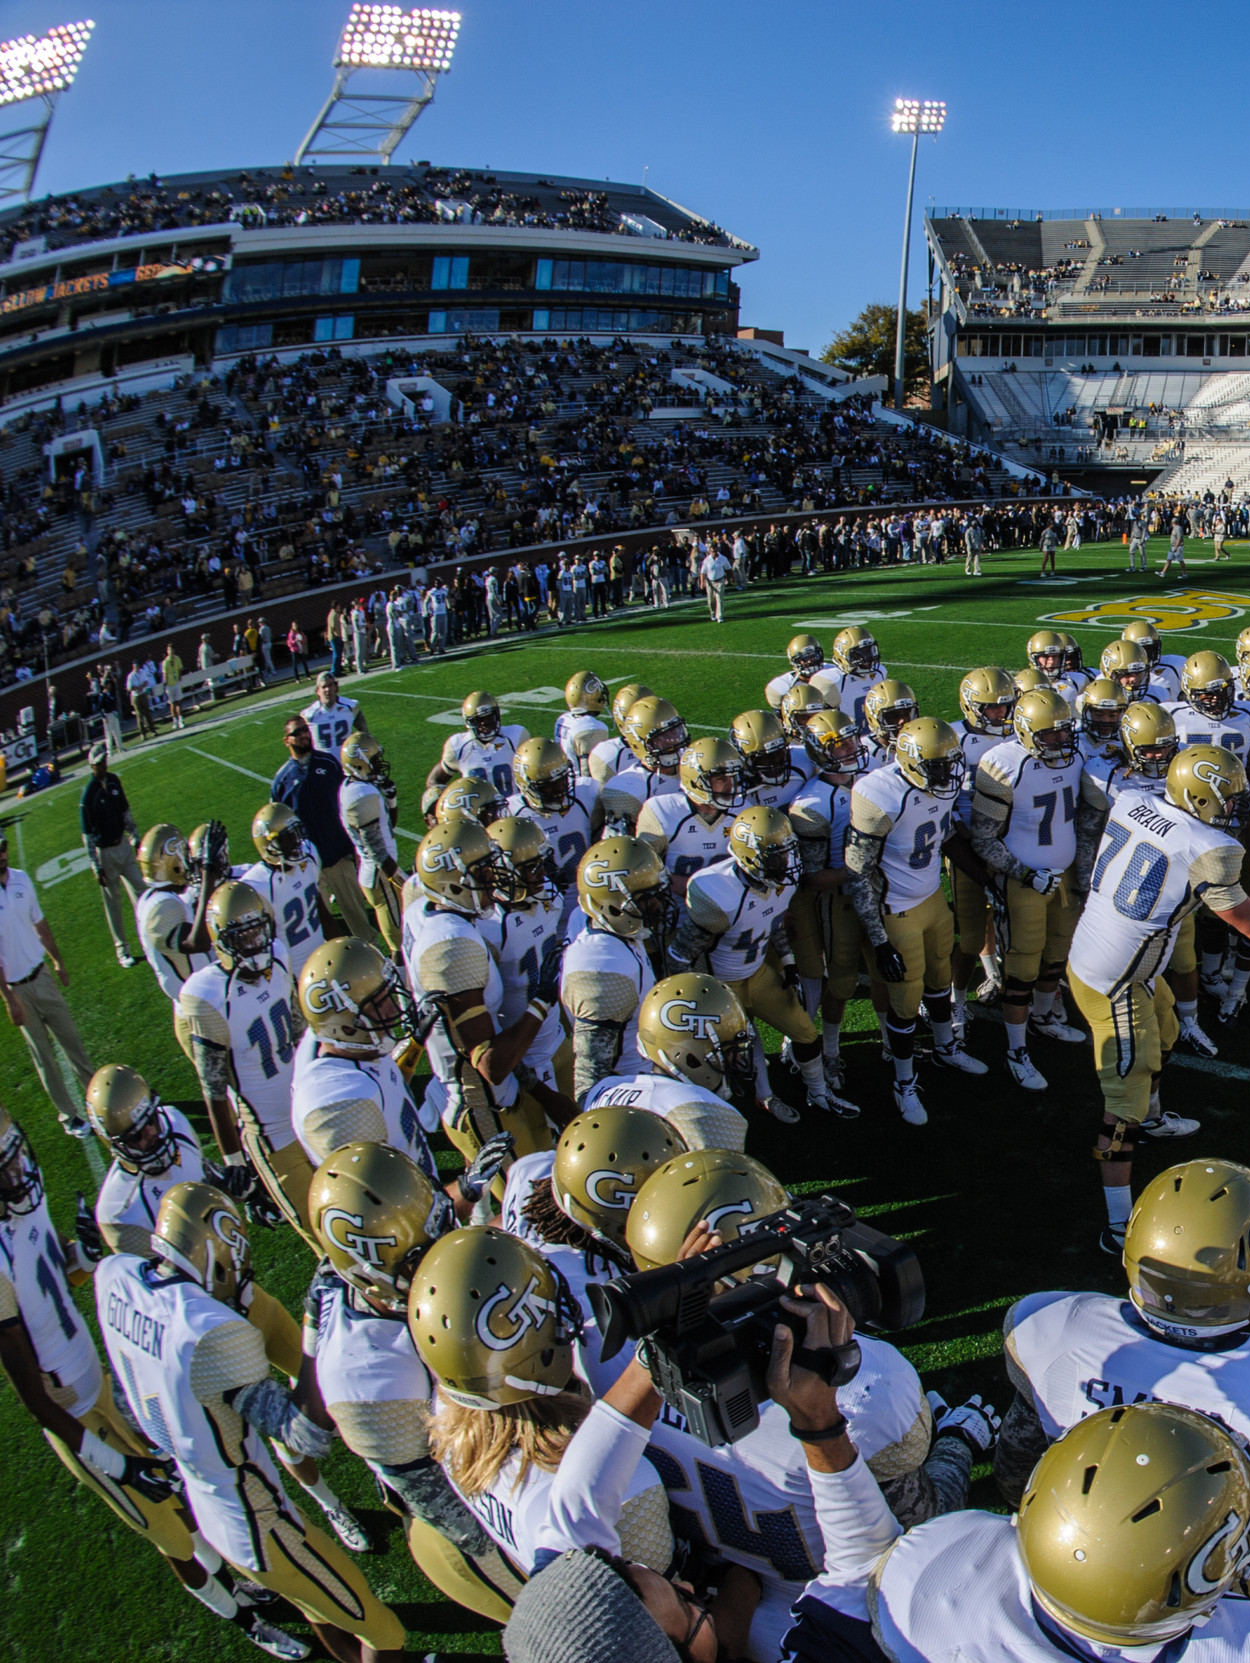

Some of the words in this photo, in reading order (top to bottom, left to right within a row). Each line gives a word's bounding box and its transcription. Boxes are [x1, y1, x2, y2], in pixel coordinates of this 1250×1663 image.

[0, 287, 48, 316] ELLOW
[50, 273, 109, 300] JACKETS
[318, 718, 350, 749] 52
[1052, 775, 1064, 784] TECH
[1192, 760, 1231, 792] GT
[447, 787, 479, 812] GT
[764, 795, 778, 805] TECH
[928, 804, 940, 815] TECH
[730, 820, 762, 849] GT
[1127, 803, 1179, 839] BRAUN
[421, 843, 463, 873] GT
[702, 841, 717, 850] TECH
[583, 860, 630, 893] GT
[1091, 818, 1171, 922] 78
[762, 906, 775, 918] TECH
[533, 924, 545, 938] TECH
[304, 978, 351, 1015] GT
[659, 998, 721, 1041] GT
[246, 997, 295, 1080] 10
[211, 1208, 251, 1264] GT
[322, 1207, 397, 1266] GT
[475, 1274, 558, 1352] GT
[1165, 1302, 1176, 1314] 12
[106, 1291, 166, 1361] GOLDEN
